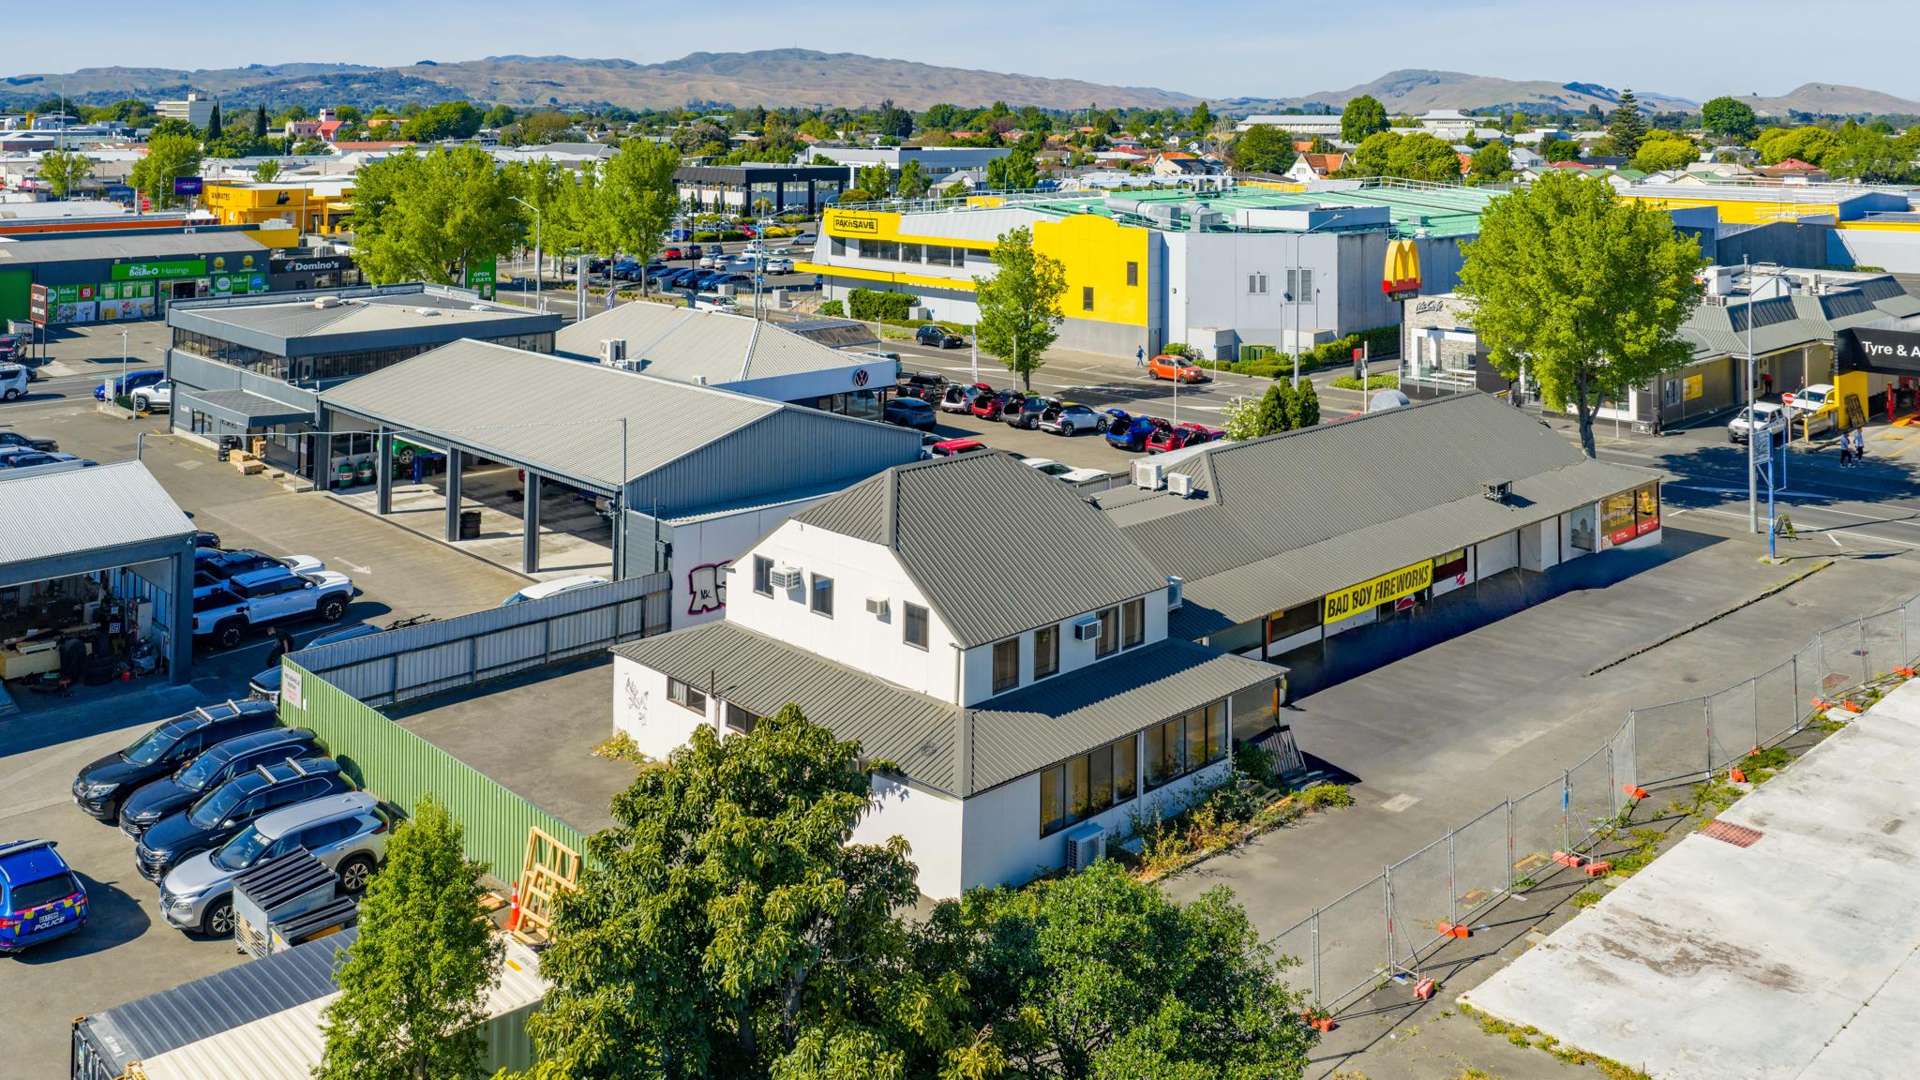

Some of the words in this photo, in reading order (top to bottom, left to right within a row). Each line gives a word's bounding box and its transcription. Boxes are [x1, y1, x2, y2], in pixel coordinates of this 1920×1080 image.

[295, 261, 339, 271] Domino's
[1861, 340, 1893, 356] Tyre
[1896, 344, 1908, 357] &
[1327, 593, 1349, 618] BAD
[1352, 586, 1373, 609] BOY
[1374, 564, 1430, 602] FIREWORKS
[33, 916, 66, 932] POLICE
